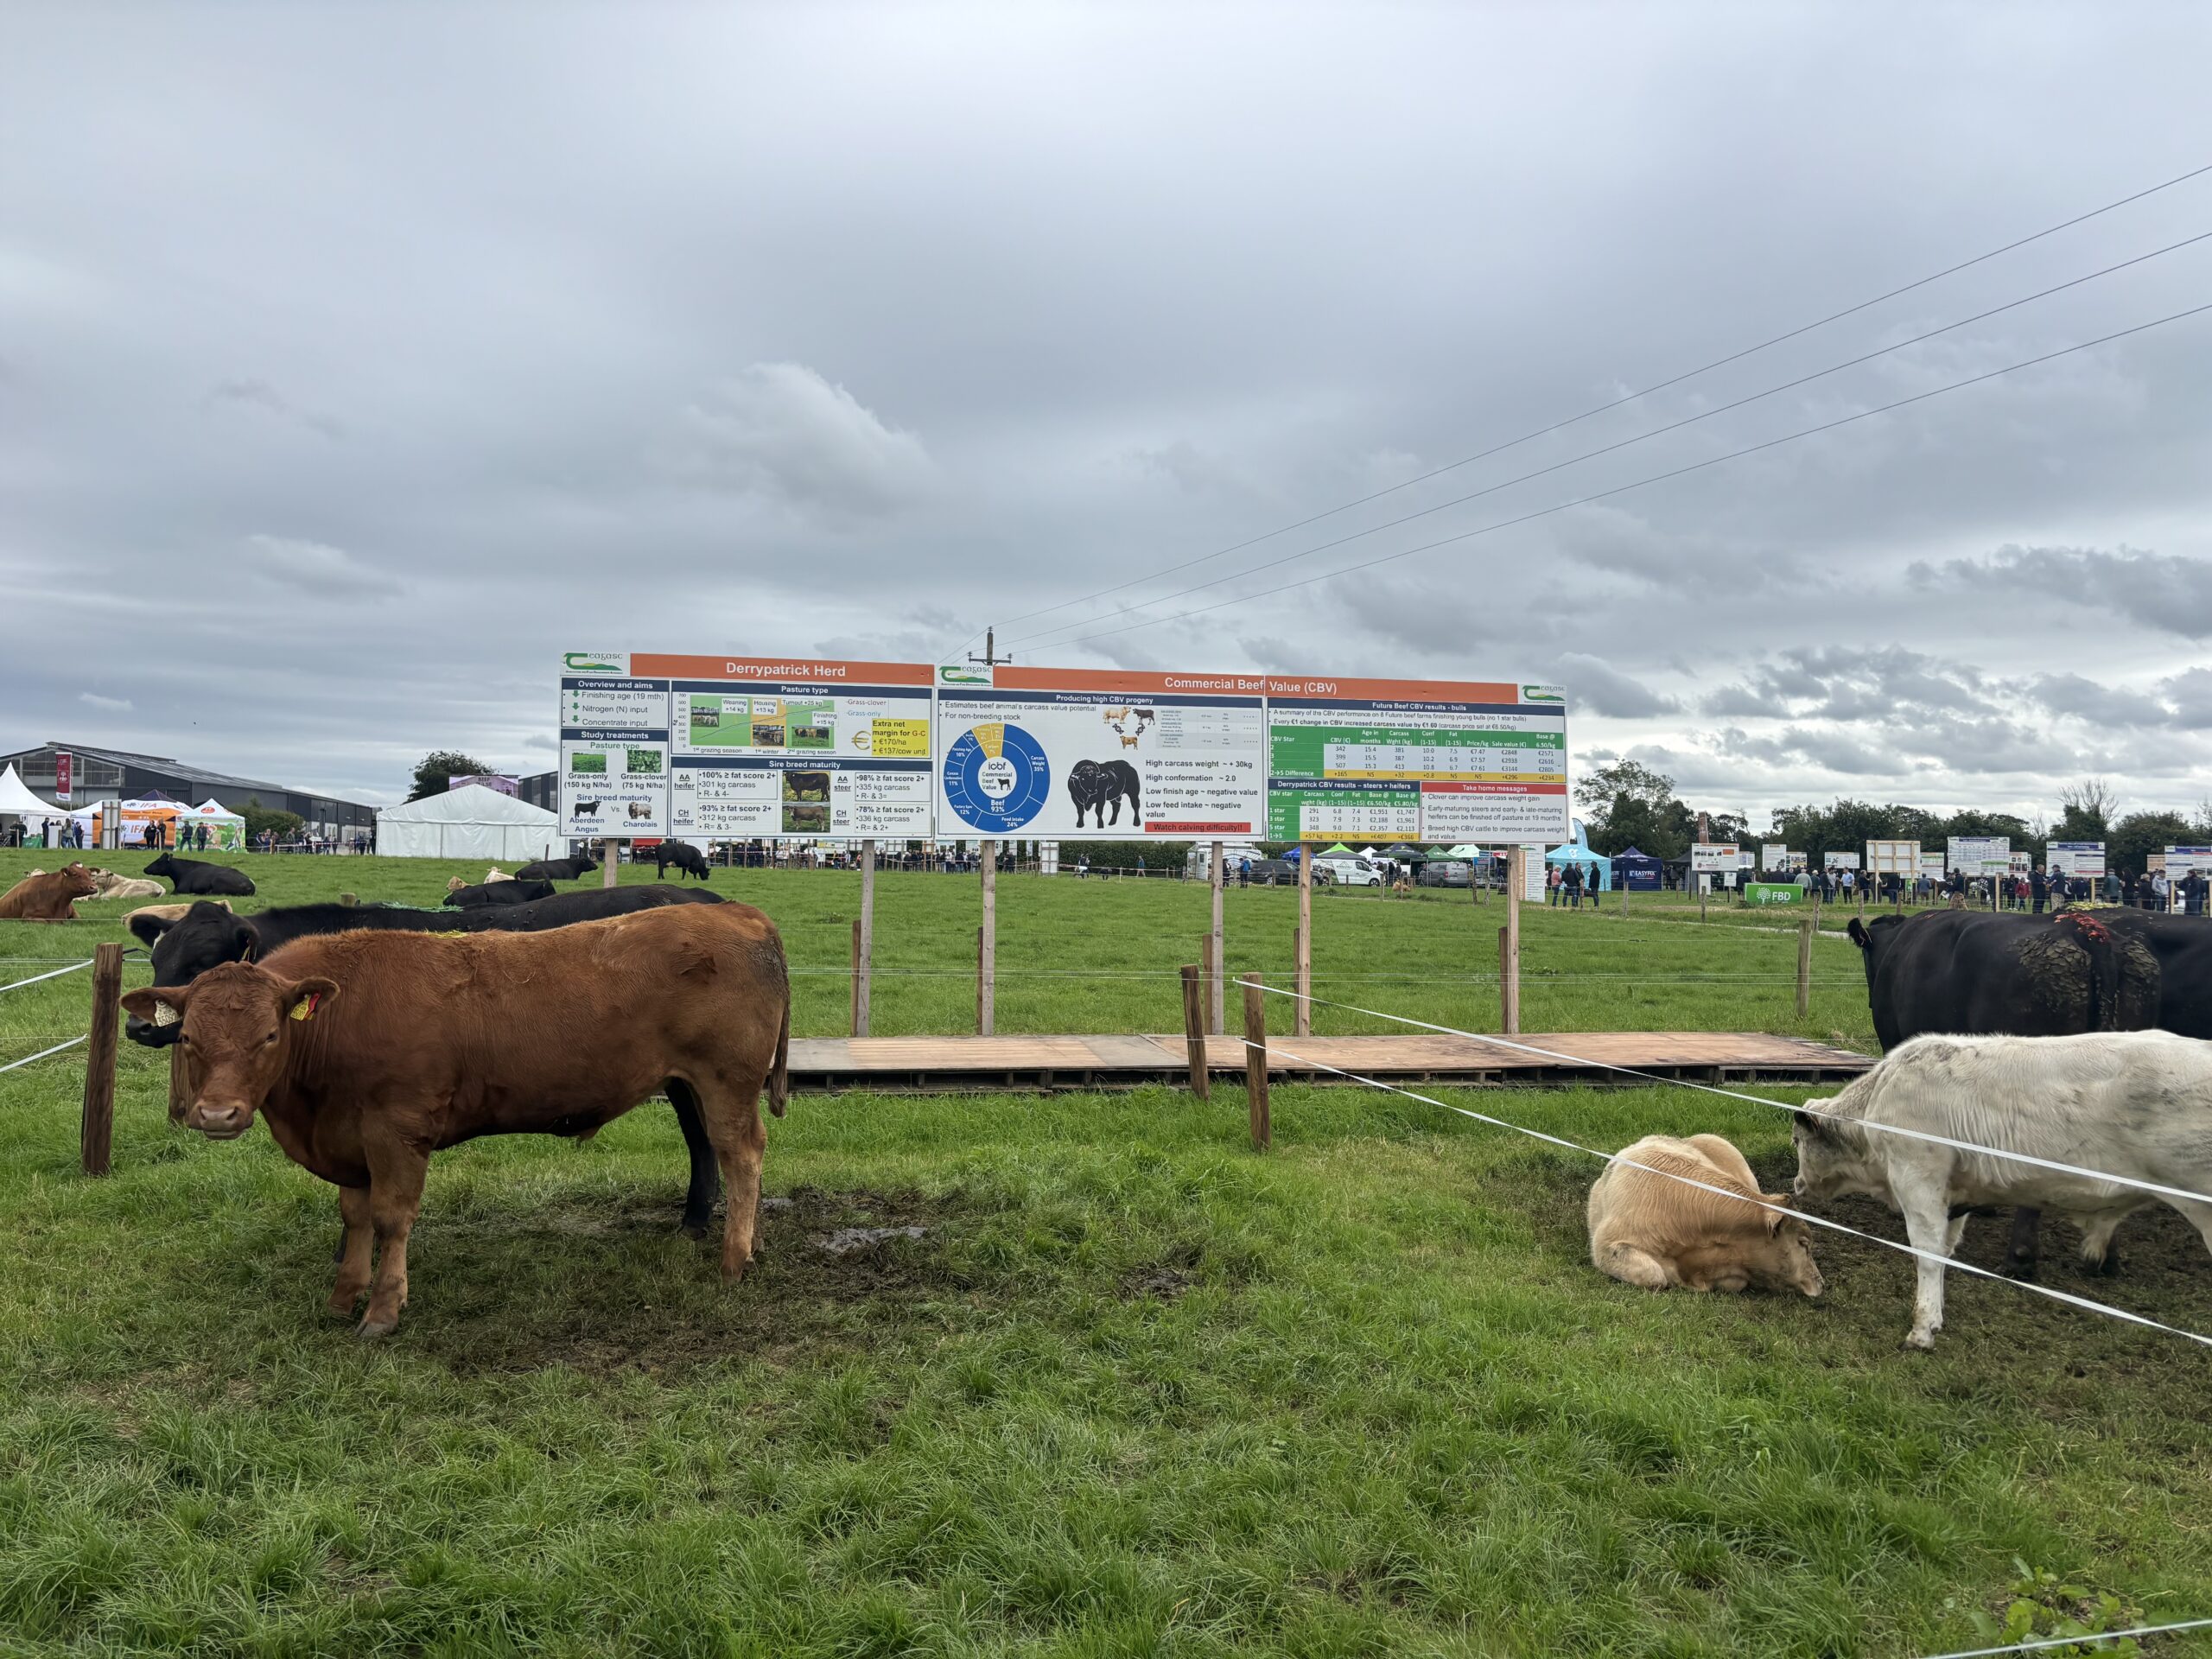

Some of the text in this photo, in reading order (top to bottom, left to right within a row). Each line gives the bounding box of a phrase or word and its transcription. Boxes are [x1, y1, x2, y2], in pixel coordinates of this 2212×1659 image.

[726, 662, 846, 677] Derrypatrick Herd
[578, 680, 615, 689] Overview
[1165, 677, 1337, 696] Commercial Beef Value (CBV)
[582, 691, 615, 701] Finishing
[647, 693, 664, 702] mth)
[582, 705, 613, 714] Nitrogen
[1146, 760, 1162, 768] High
[1195, 760, 1219, 769] weight
[568, 772, 608, 781] Grass-only
[1146, 774, 1162, 783] High
[1211, 802, 1241, 810] negative
[130, 824, 146, 834] IFA
[1772, 891, 1791, 901] FBD
